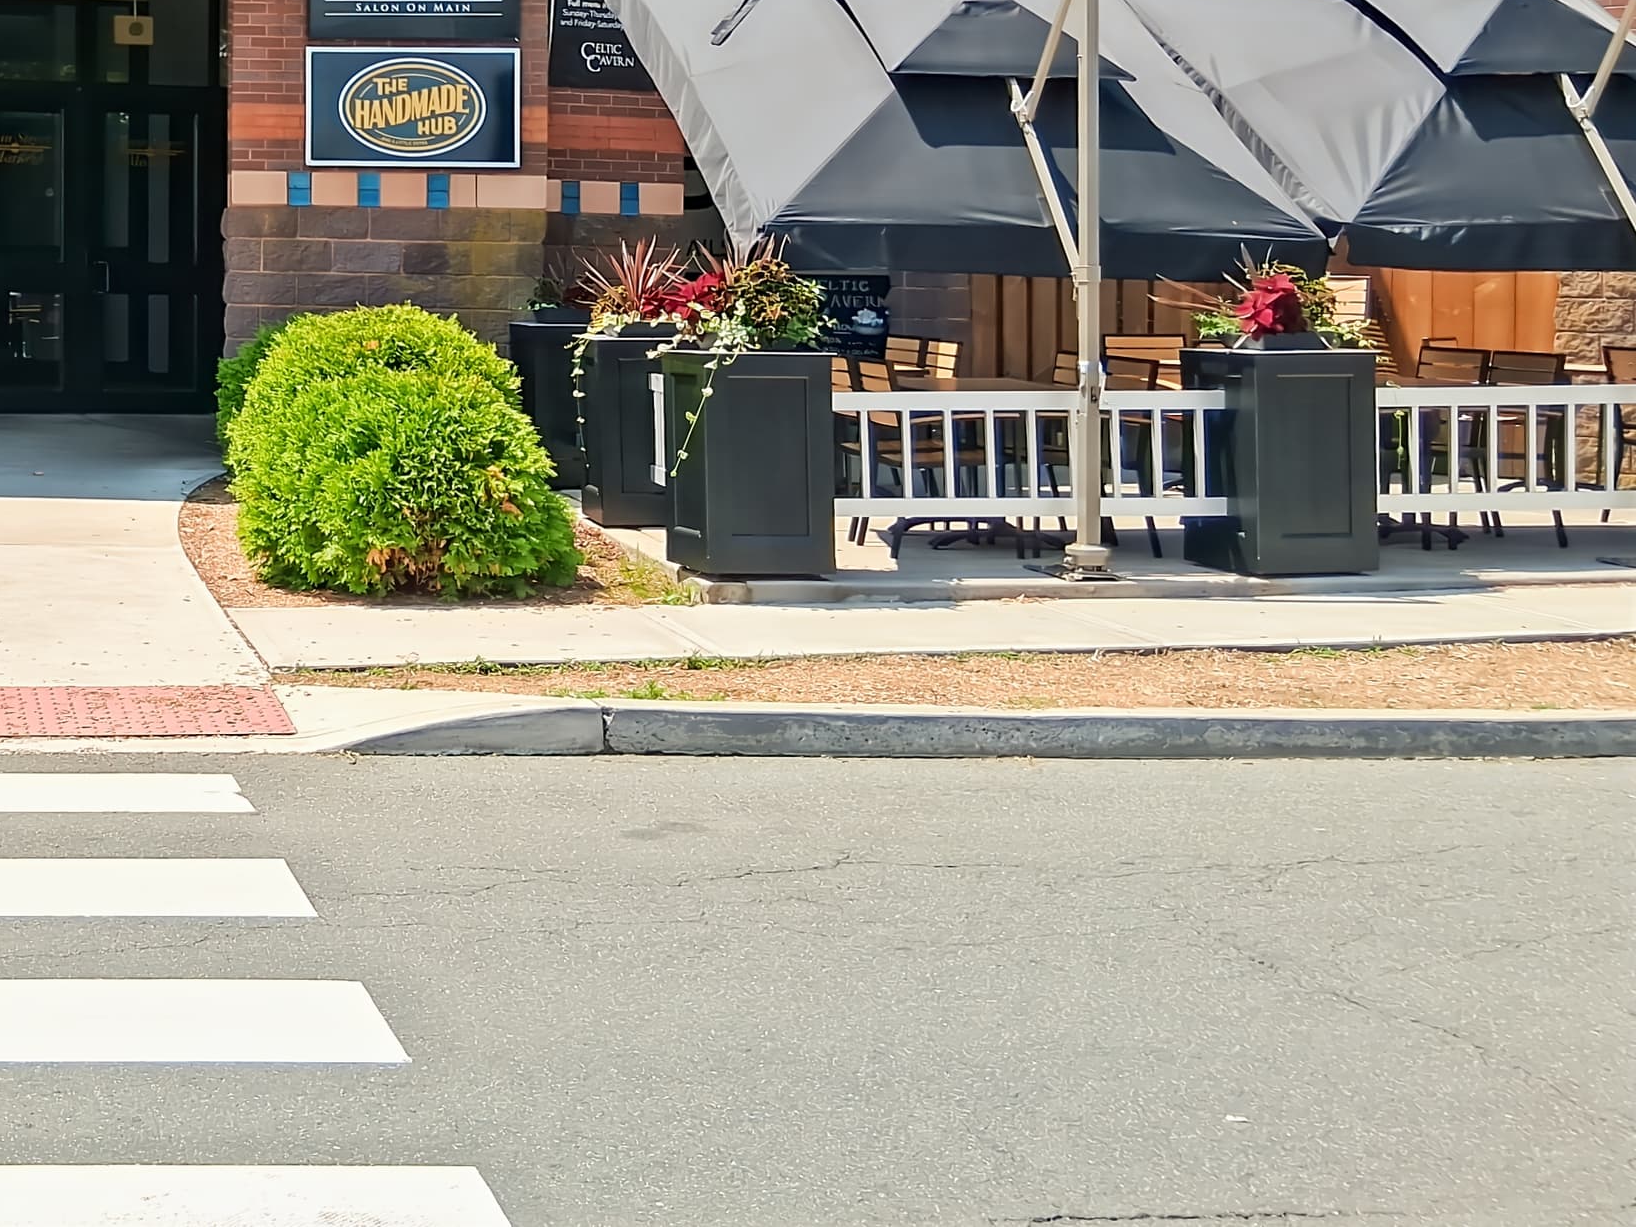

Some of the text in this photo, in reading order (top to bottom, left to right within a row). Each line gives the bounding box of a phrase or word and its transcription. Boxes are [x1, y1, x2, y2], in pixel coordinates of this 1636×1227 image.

[580, 41, 623, 60] CELTIC
[586, 54, 635, 72] CAVERN
[373, 77, 408, 95] THE
[353, 83, 471, 130] HANDMADE
[417, 116, 458, 136] HUB
